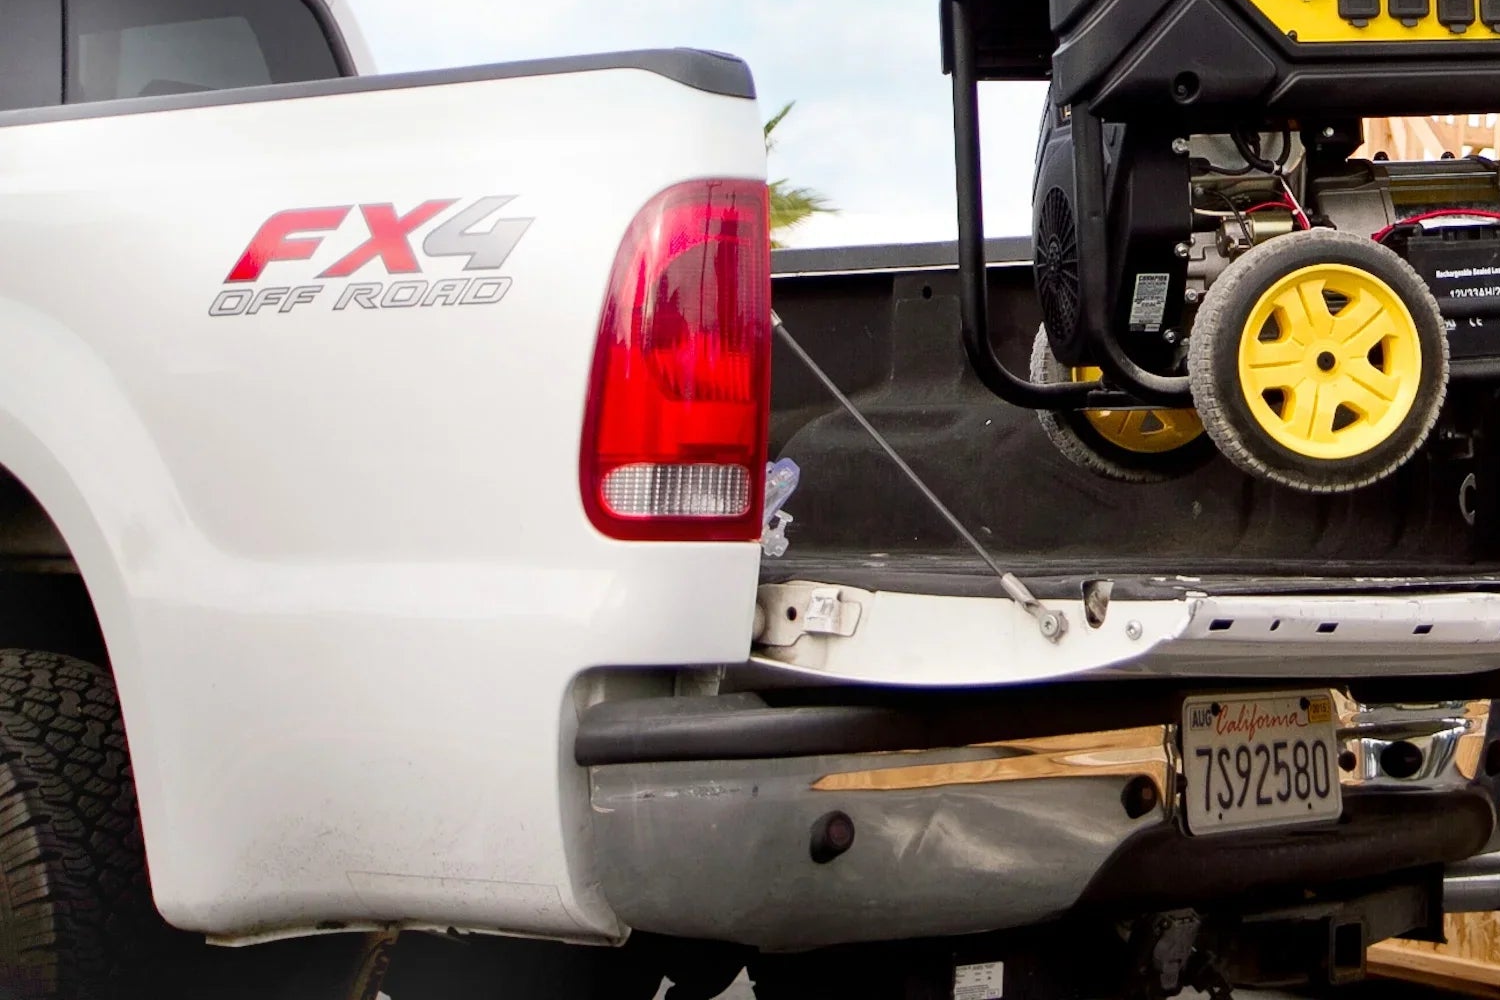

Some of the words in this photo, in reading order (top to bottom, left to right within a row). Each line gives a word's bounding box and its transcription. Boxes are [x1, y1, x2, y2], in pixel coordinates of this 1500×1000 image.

[223, 194, 536, 284] FX4
[1435, 269, 1473, 279] Rechargeable
[208, 285, 325, 316] OFF
[332, 276, 513, 311] ROAD
[1192, 708, 1213, 727] AUG
[1215, 703, 1308, 742] California
[1196, 740, 1331, 812] 7S92580
